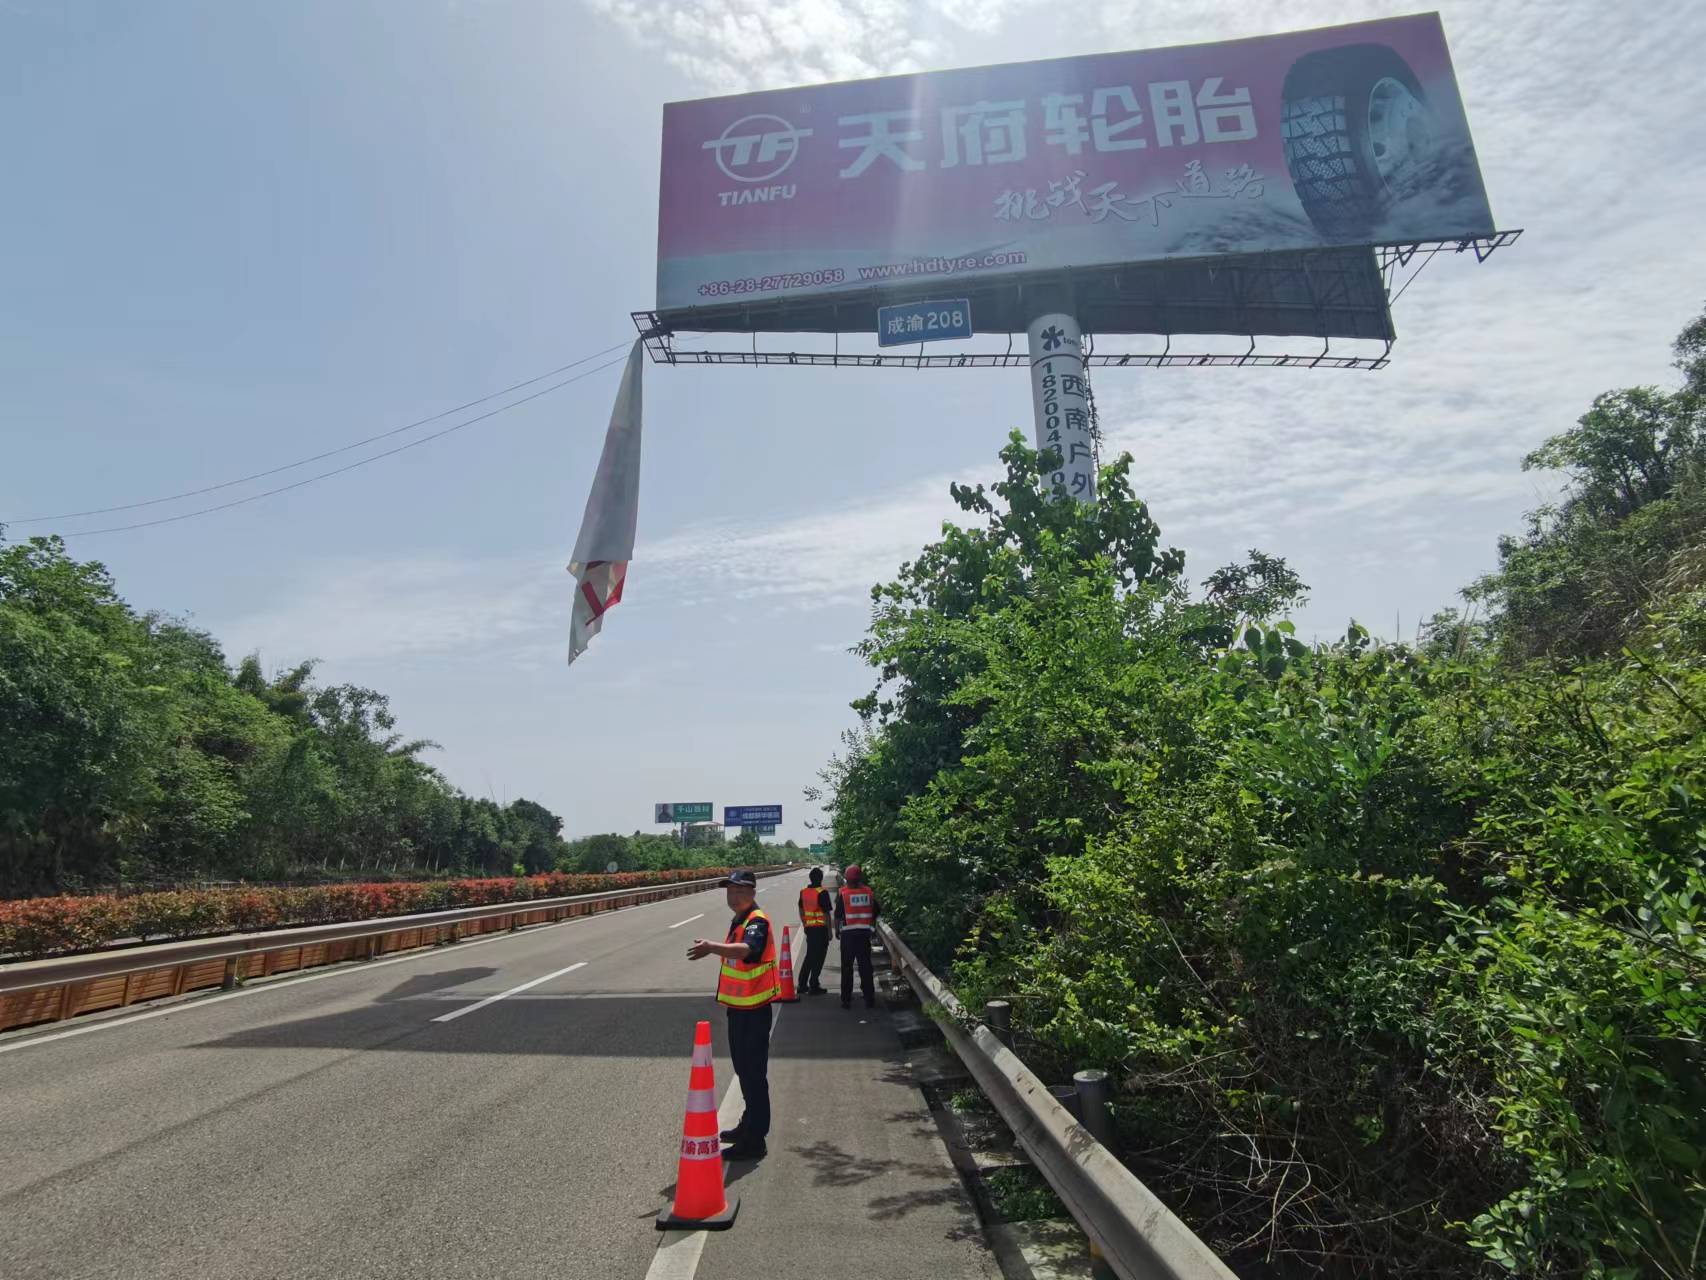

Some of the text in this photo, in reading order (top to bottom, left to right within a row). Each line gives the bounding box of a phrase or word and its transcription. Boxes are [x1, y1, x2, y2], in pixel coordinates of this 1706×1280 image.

[837, 77, 1258, 179] 天府轮胎
[718, 183, 797, 207] TIANFU
[858, 250, 1027, 280] www.hdtyre.com
[698, 267, 846, 297] +86-28-27729058
[886, 309, 965, 336] 成渝208
[1060, 374, 1095, 497] 西南户外
